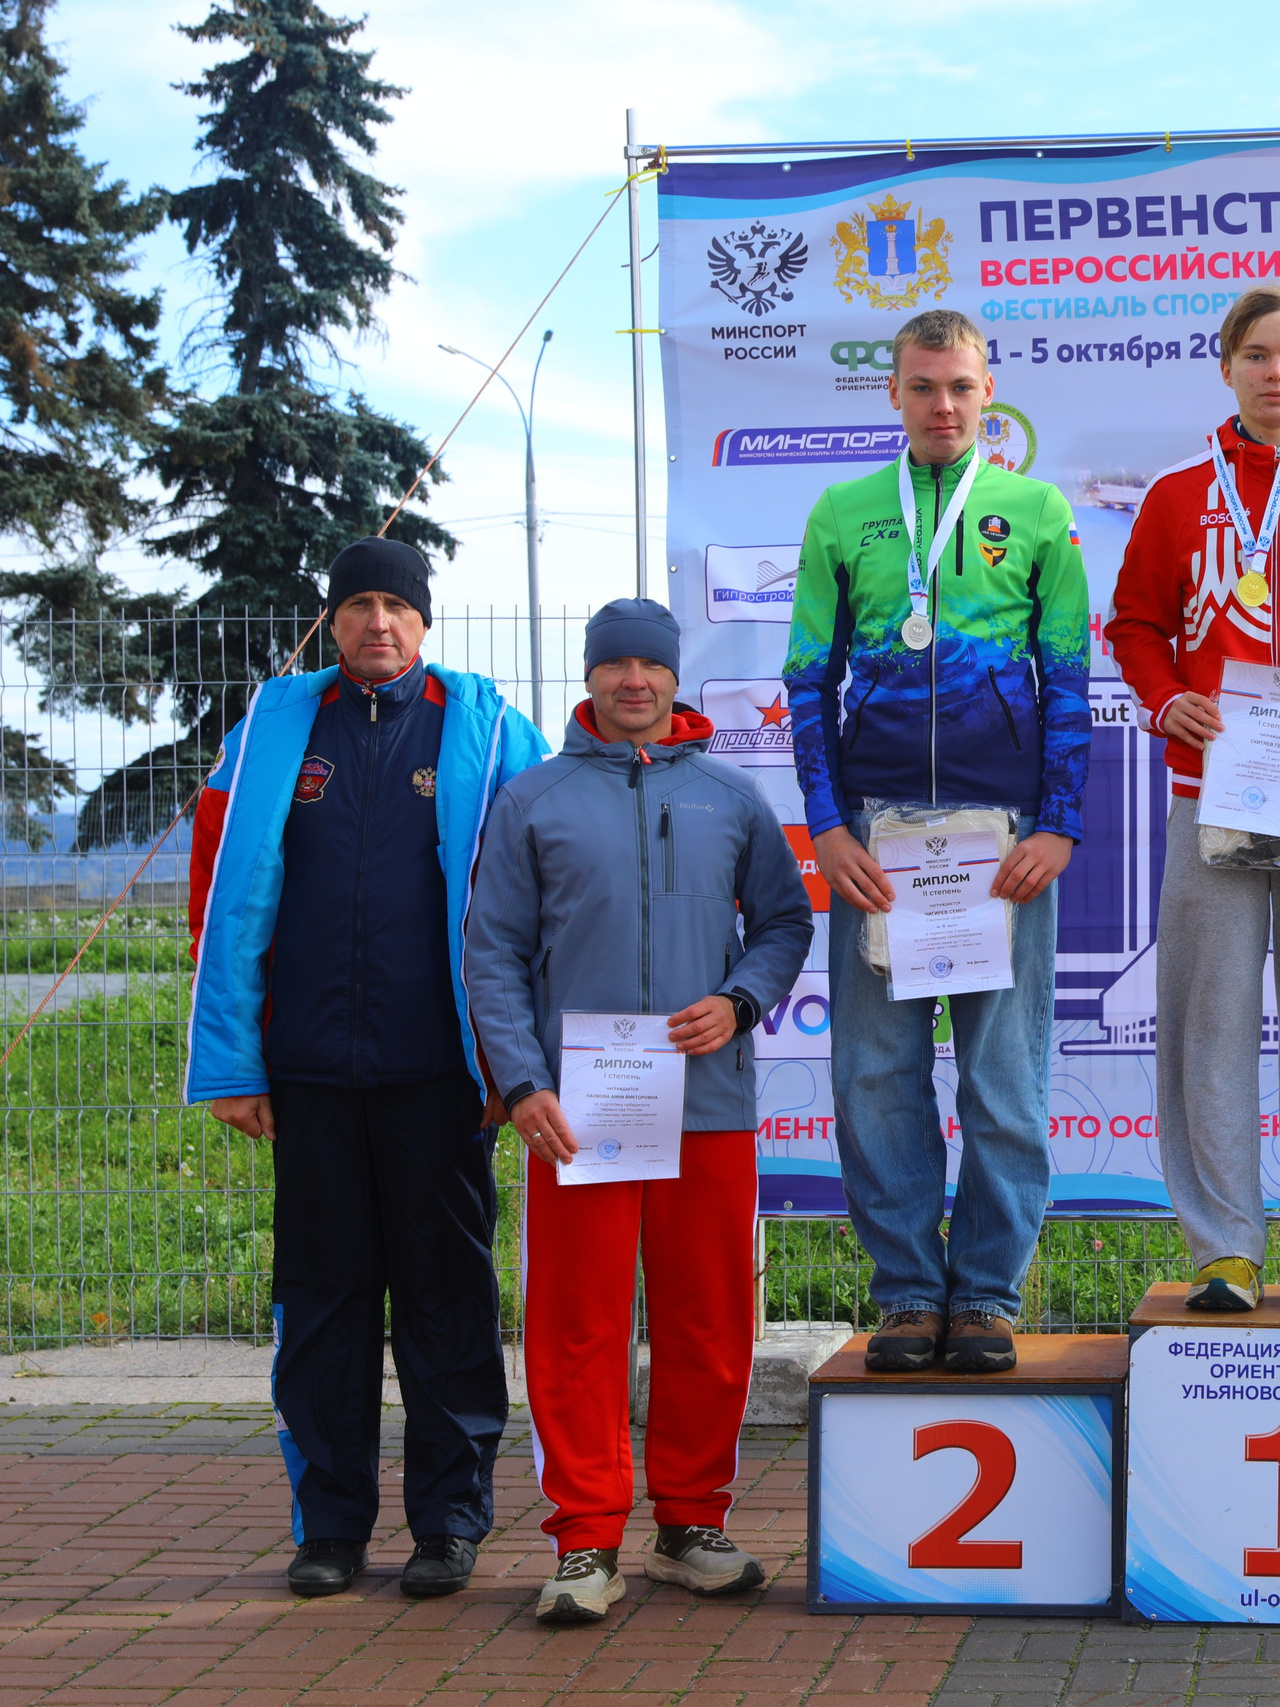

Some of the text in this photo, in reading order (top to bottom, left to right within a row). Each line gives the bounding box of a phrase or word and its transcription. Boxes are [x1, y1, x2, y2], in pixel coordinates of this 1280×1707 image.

[980, 295, 1147, 323] ФЕСТИВАЛЬ
[711, 324, 807, 340] МИНСПОРТ
[724, 345, 797, 360] РОССИИ
[987, 339, 1002, 364] 1
[1031, 337, 1049, 364] 5
[1056, 334, 1182, 368] октября
[1188, 332, 1221, 359] 20
[835, 375, 890, 384] ФЕДЕРАЦИЯ
[835, 383, 890, 391] ОРИЕНТИРО
[740, 430, 909, 451] МИНСПОРТ
[1216, 454, 1247, 535] МИНИСТЕРСТВО СПОРТА РОССИИ
[862, 518, 903, 531] ГРУППА
[1200, 514, 1234, 526] BOSC
[912, 873, 970, 889] ДИПЛОМ
[929, 888, 961, 896] степень
[594, 1058, 653, 1070] ДИПЛОМ
[908, 1419, 1023, 1569] 2
